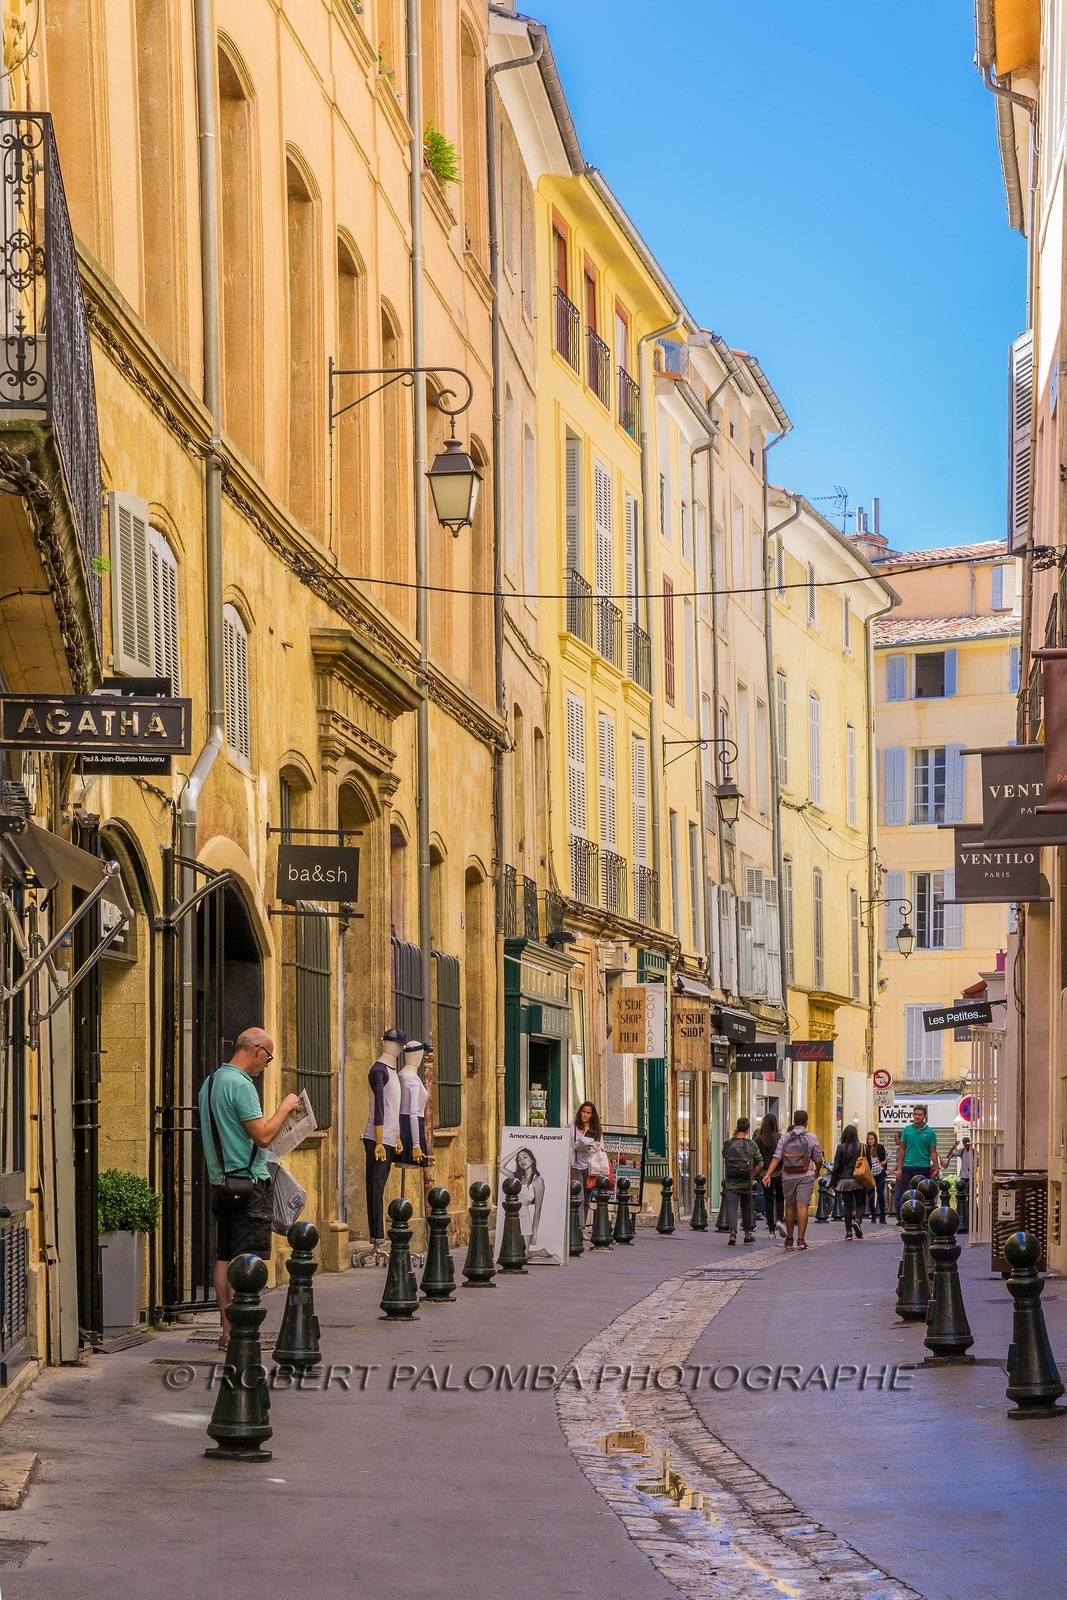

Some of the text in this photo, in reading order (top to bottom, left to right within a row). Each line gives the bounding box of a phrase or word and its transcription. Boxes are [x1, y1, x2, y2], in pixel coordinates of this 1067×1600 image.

[18, 708, 168, 738] AGATHA
[100, 755, 138, 763] Jean-Baptiste
[989, 783, 1044, 798] VENT
[960, 853, 1035, 865] VENTILO
[288, 864, 348, 883] ba&sh
[620, 1013, 642, 1024] SHOP
[647, 995, 655, 1052] GOULARD
[677, 1013, 706, 1025] N'SIDE
[928, 1016, 945, 1026] Les
[620, 1032, 639, 1043] MEN
[680, 1027, 705, 1038] SHOP
[882, 1108, 915, 1119] Wolfor
